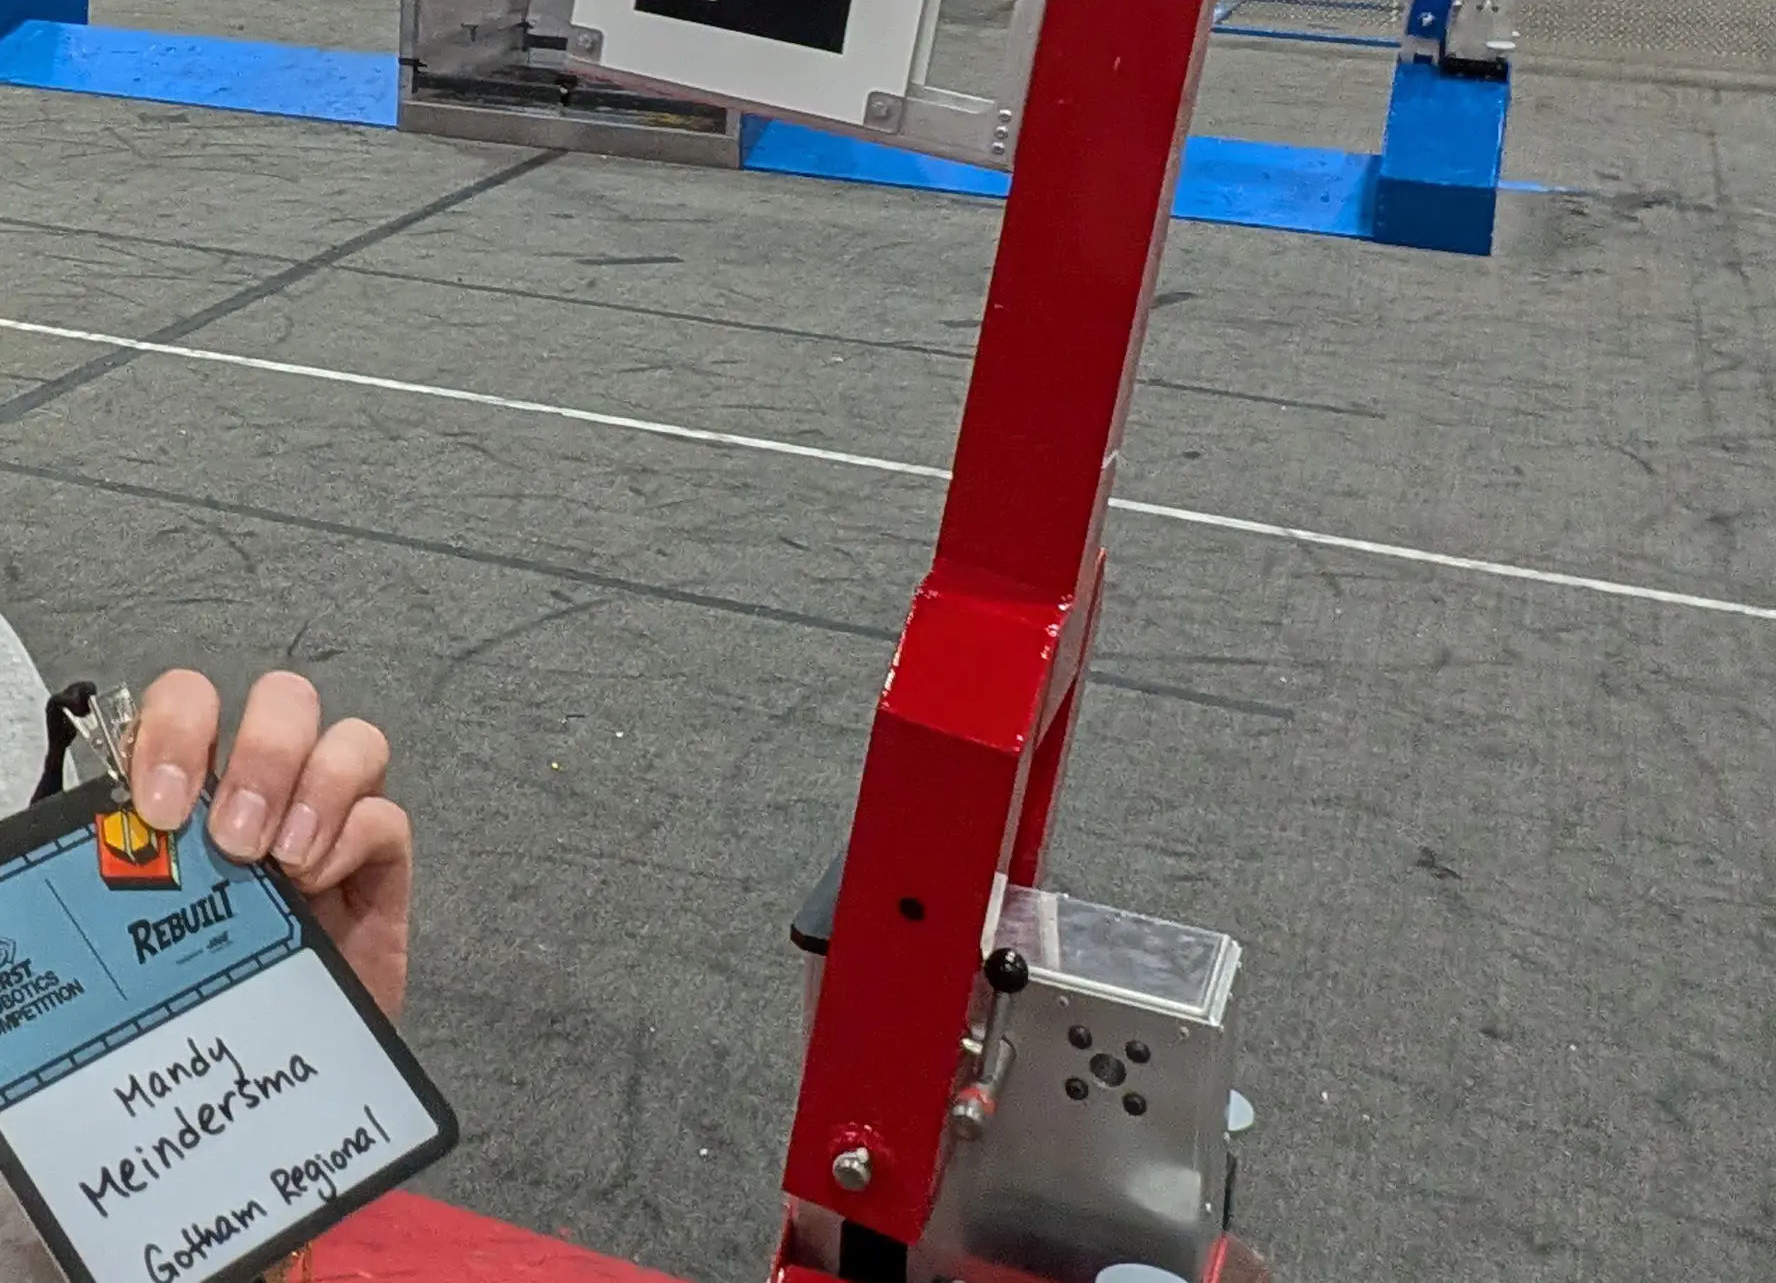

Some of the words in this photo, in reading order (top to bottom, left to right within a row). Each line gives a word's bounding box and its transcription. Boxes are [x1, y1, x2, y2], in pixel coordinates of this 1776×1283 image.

[127, 878, 234, 965] REBUILT
[79, 1054, 319, 1218] Meindersma
[113, 1036, 248, 1118] Mandy
[144, 1199, 268, 1283] Gotham
[270, 1104, 392, 1204] Regional
